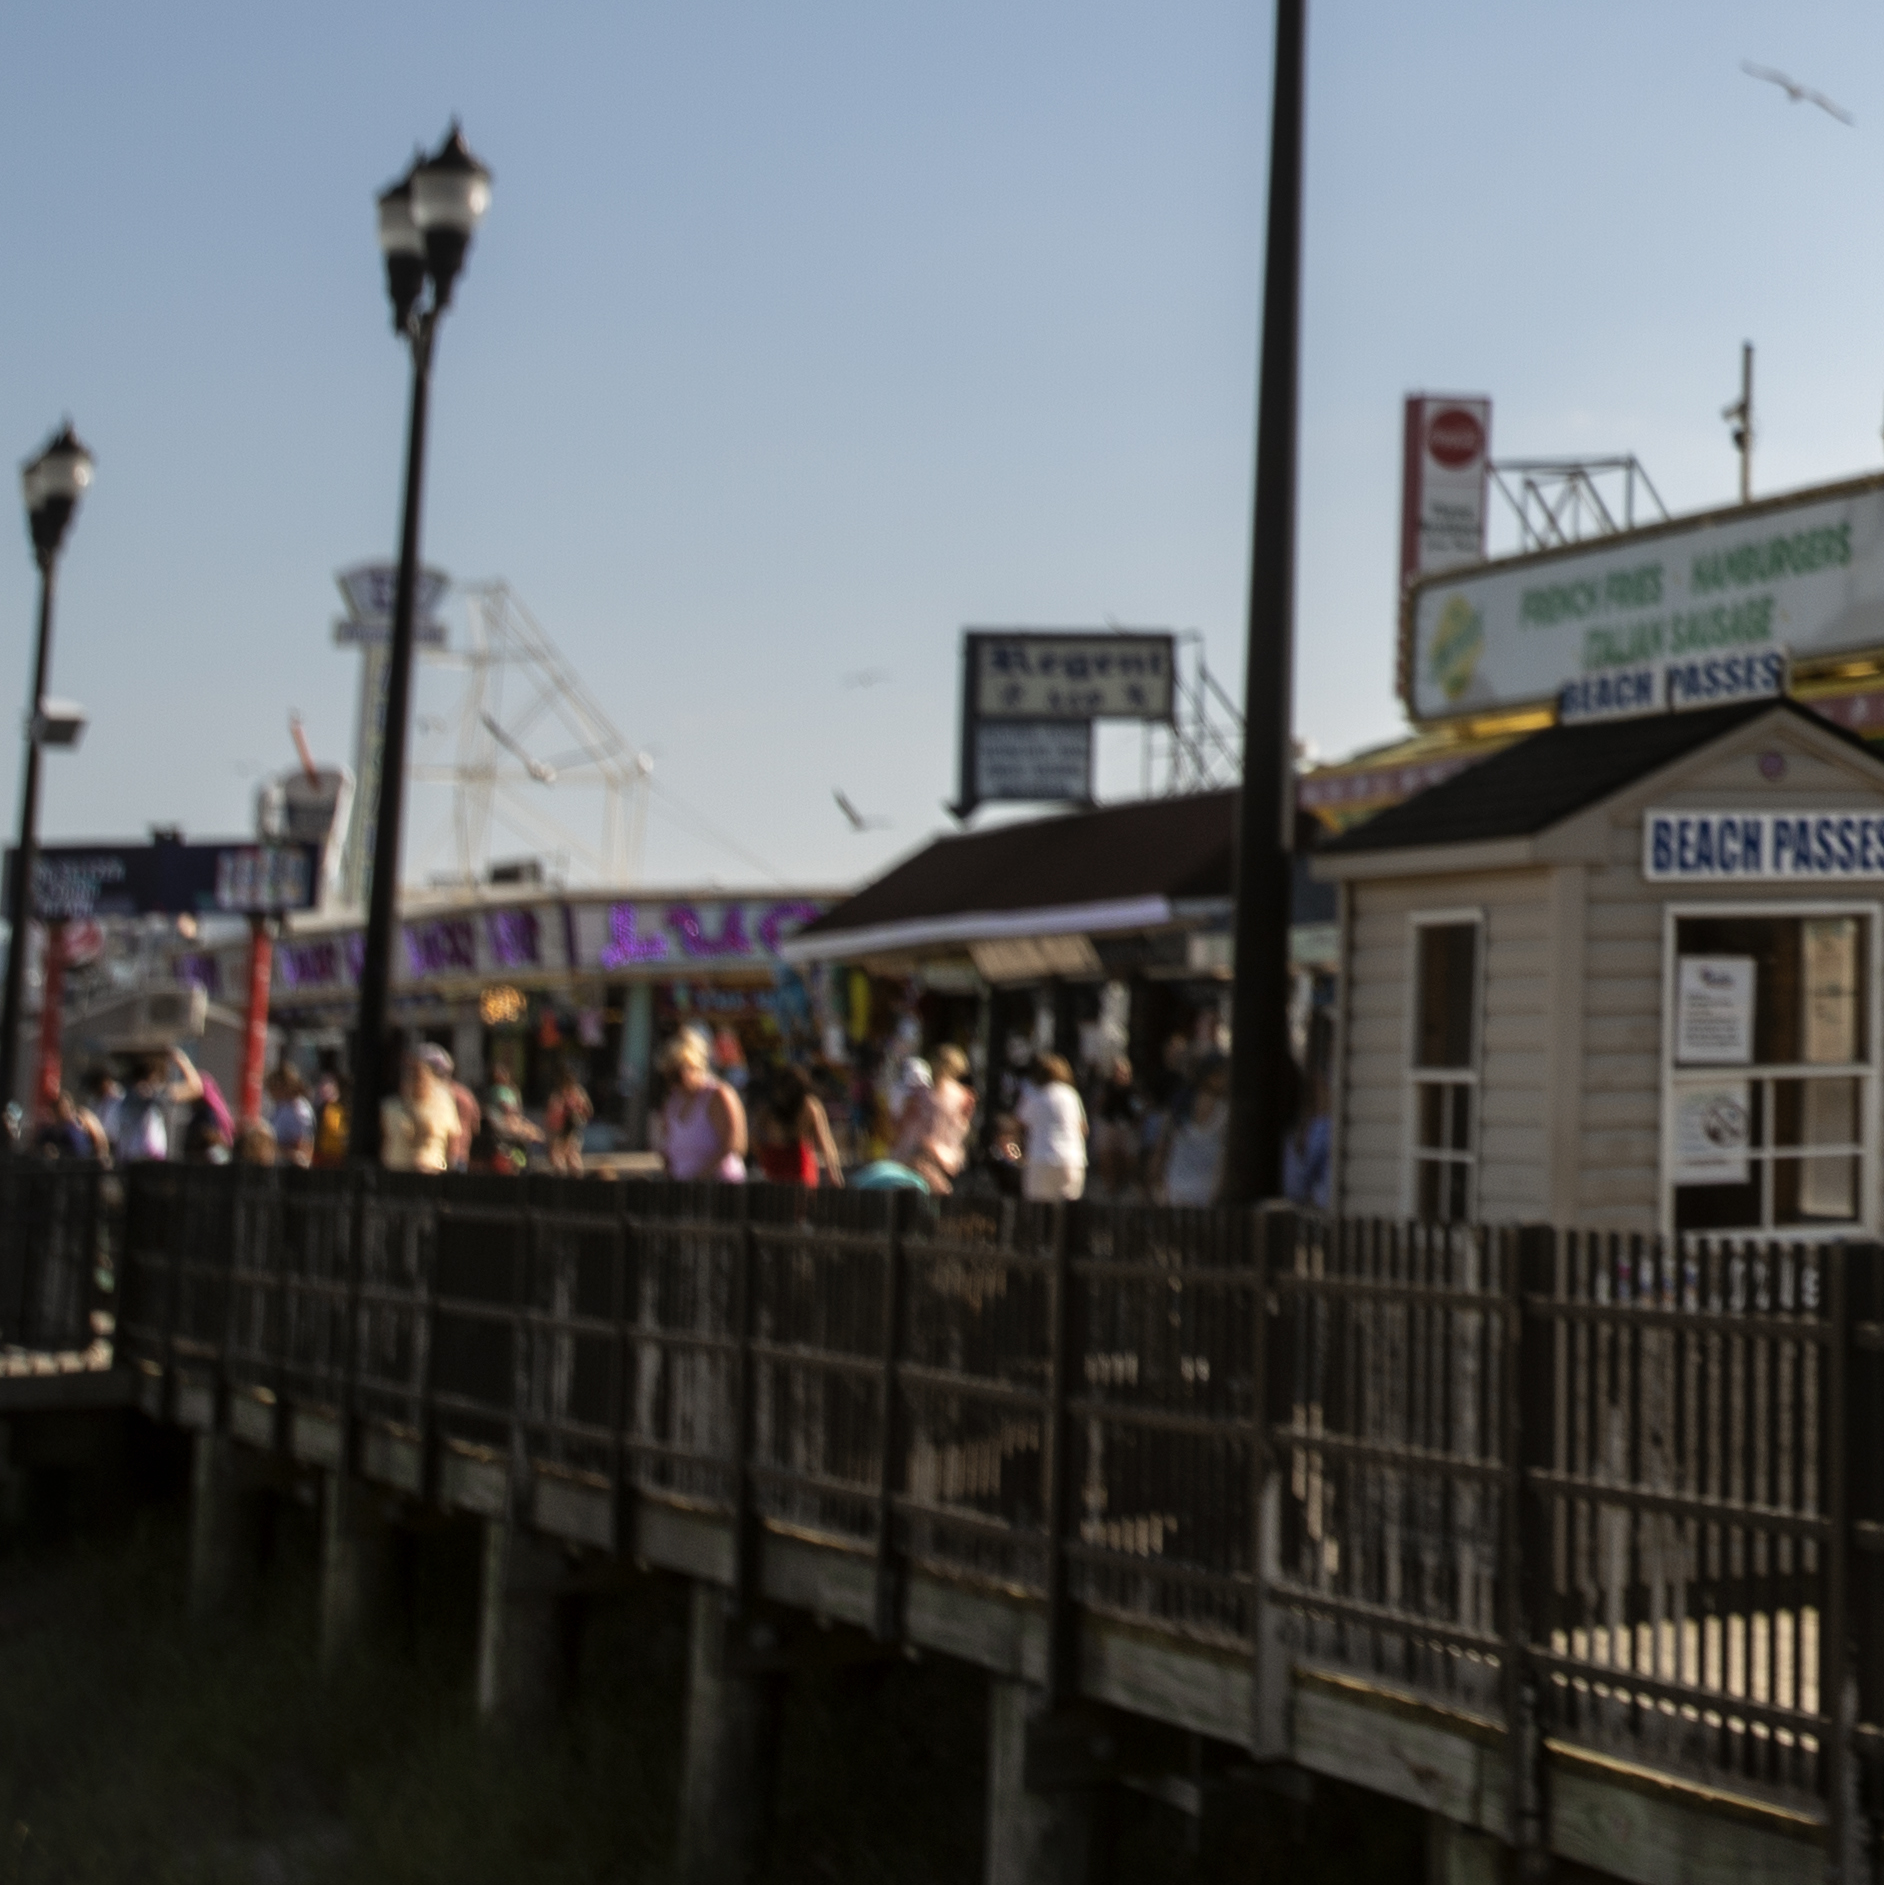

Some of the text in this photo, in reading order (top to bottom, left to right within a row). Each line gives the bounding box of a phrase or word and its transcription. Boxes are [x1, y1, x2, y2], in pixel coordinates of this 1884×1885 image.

[1561, 652, 1783, 714] BEACH PASSES
[1652, 819, 1764, 872] BEACH
